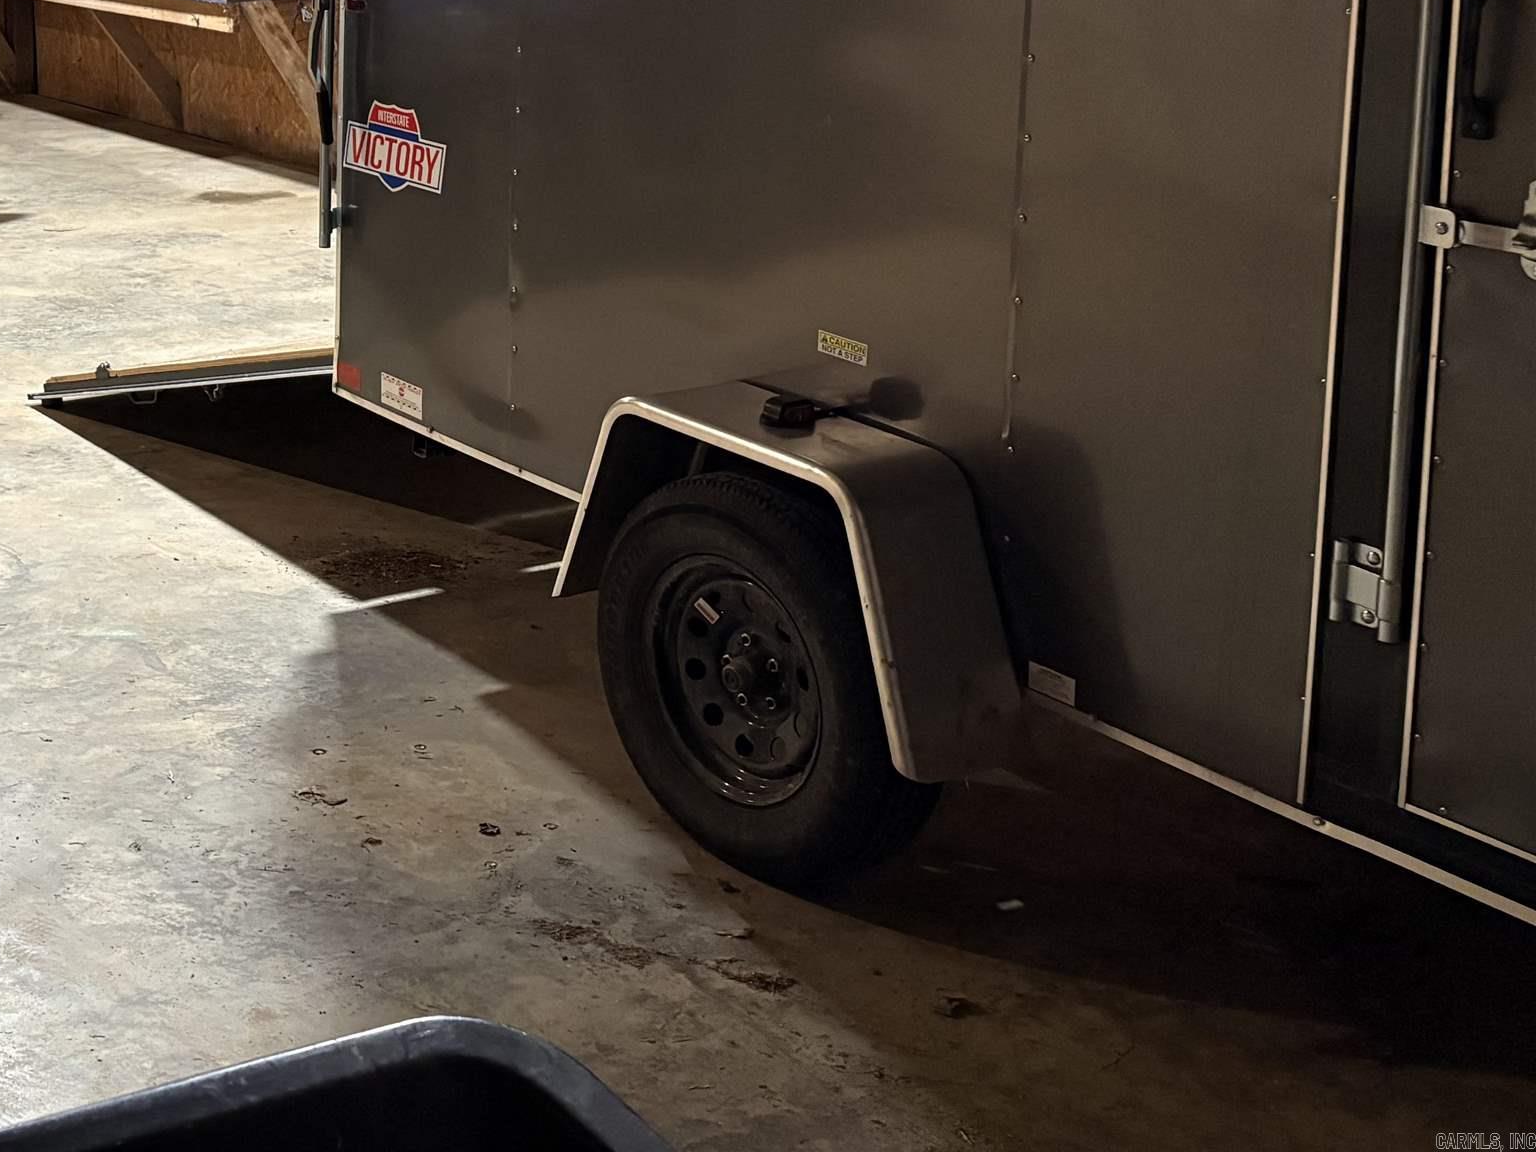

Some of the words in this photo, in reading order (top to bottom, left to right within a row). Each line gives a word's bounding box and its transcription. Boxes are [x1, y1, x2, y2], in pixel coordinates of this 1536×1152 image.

[377, 109, 410, 129] INTERSTATE
[352, 127, 440, 184] VICTORY
[821, 344, 837, 355] NOT
[844, 351, 864, 363] STEP
[829, 336, 865, 355] CAUTION
